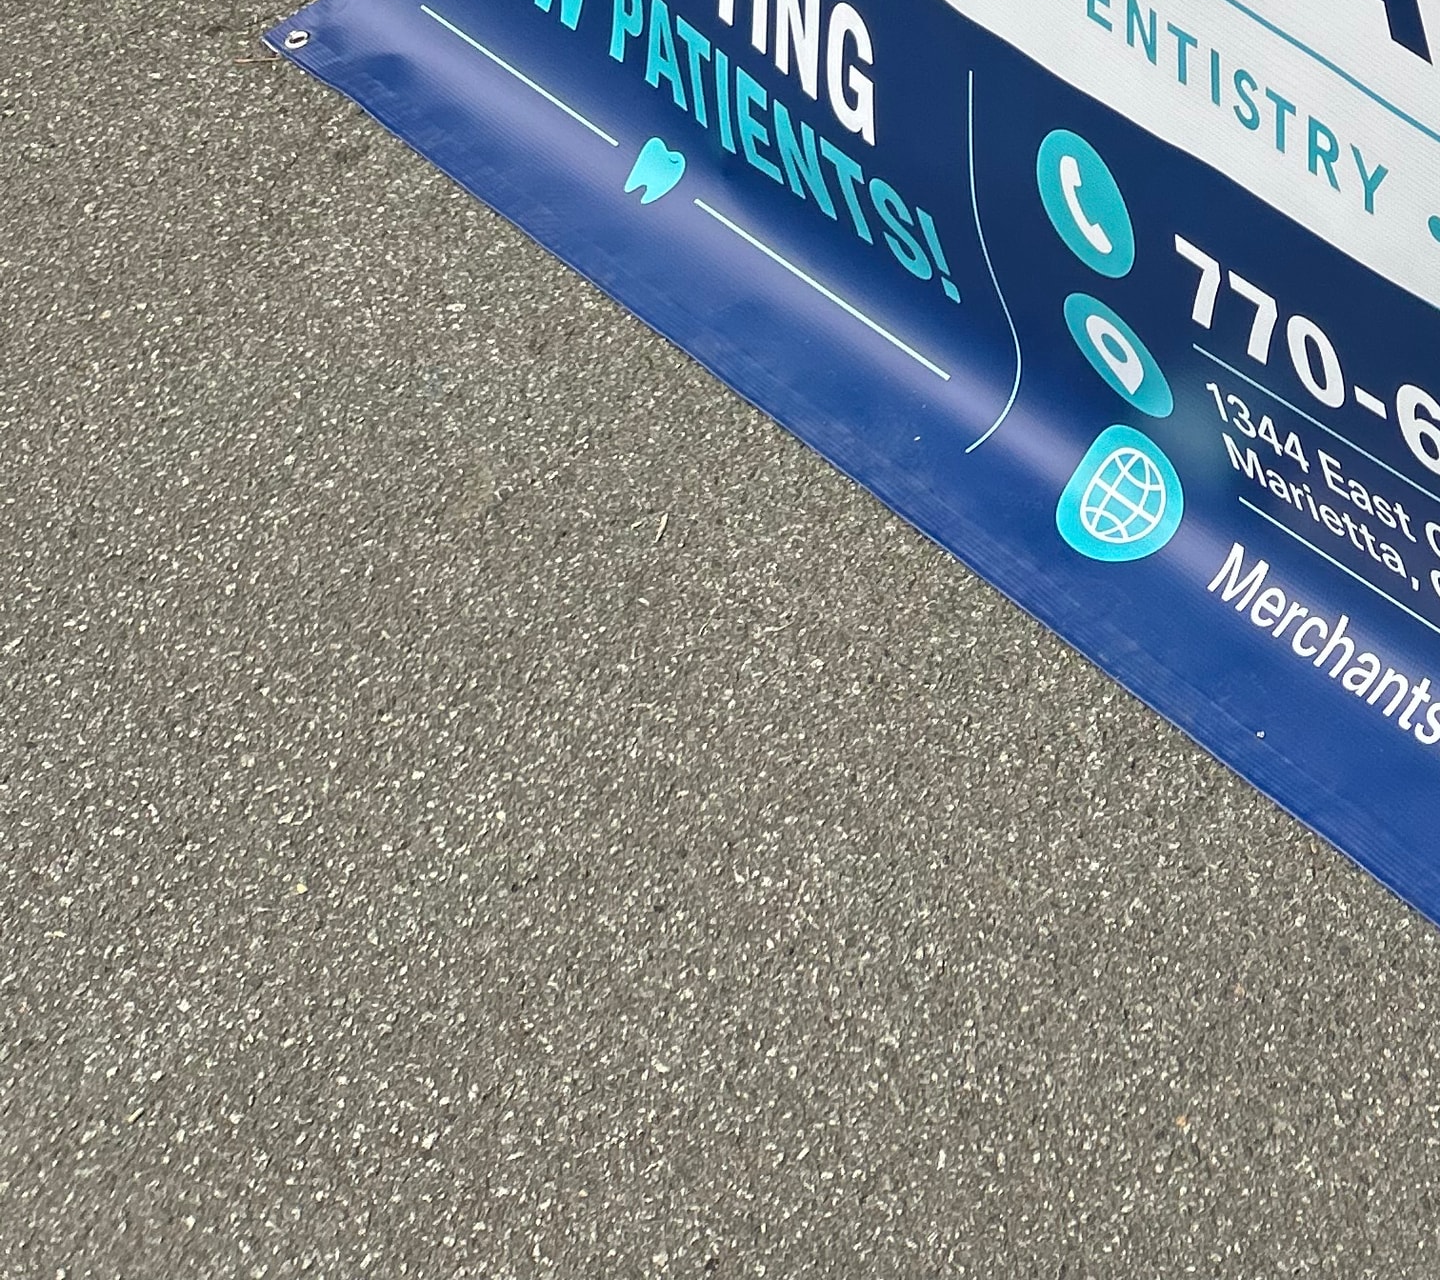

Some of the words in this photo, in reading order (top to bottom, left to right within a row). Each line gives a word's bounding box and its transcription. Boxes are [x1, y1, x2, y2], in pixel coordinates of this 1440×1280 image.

[1206, 381, 1310, 473] 1344
[1320, 450, 1416, 544] East
[1222, 433, 1420, 590] Marietta,
